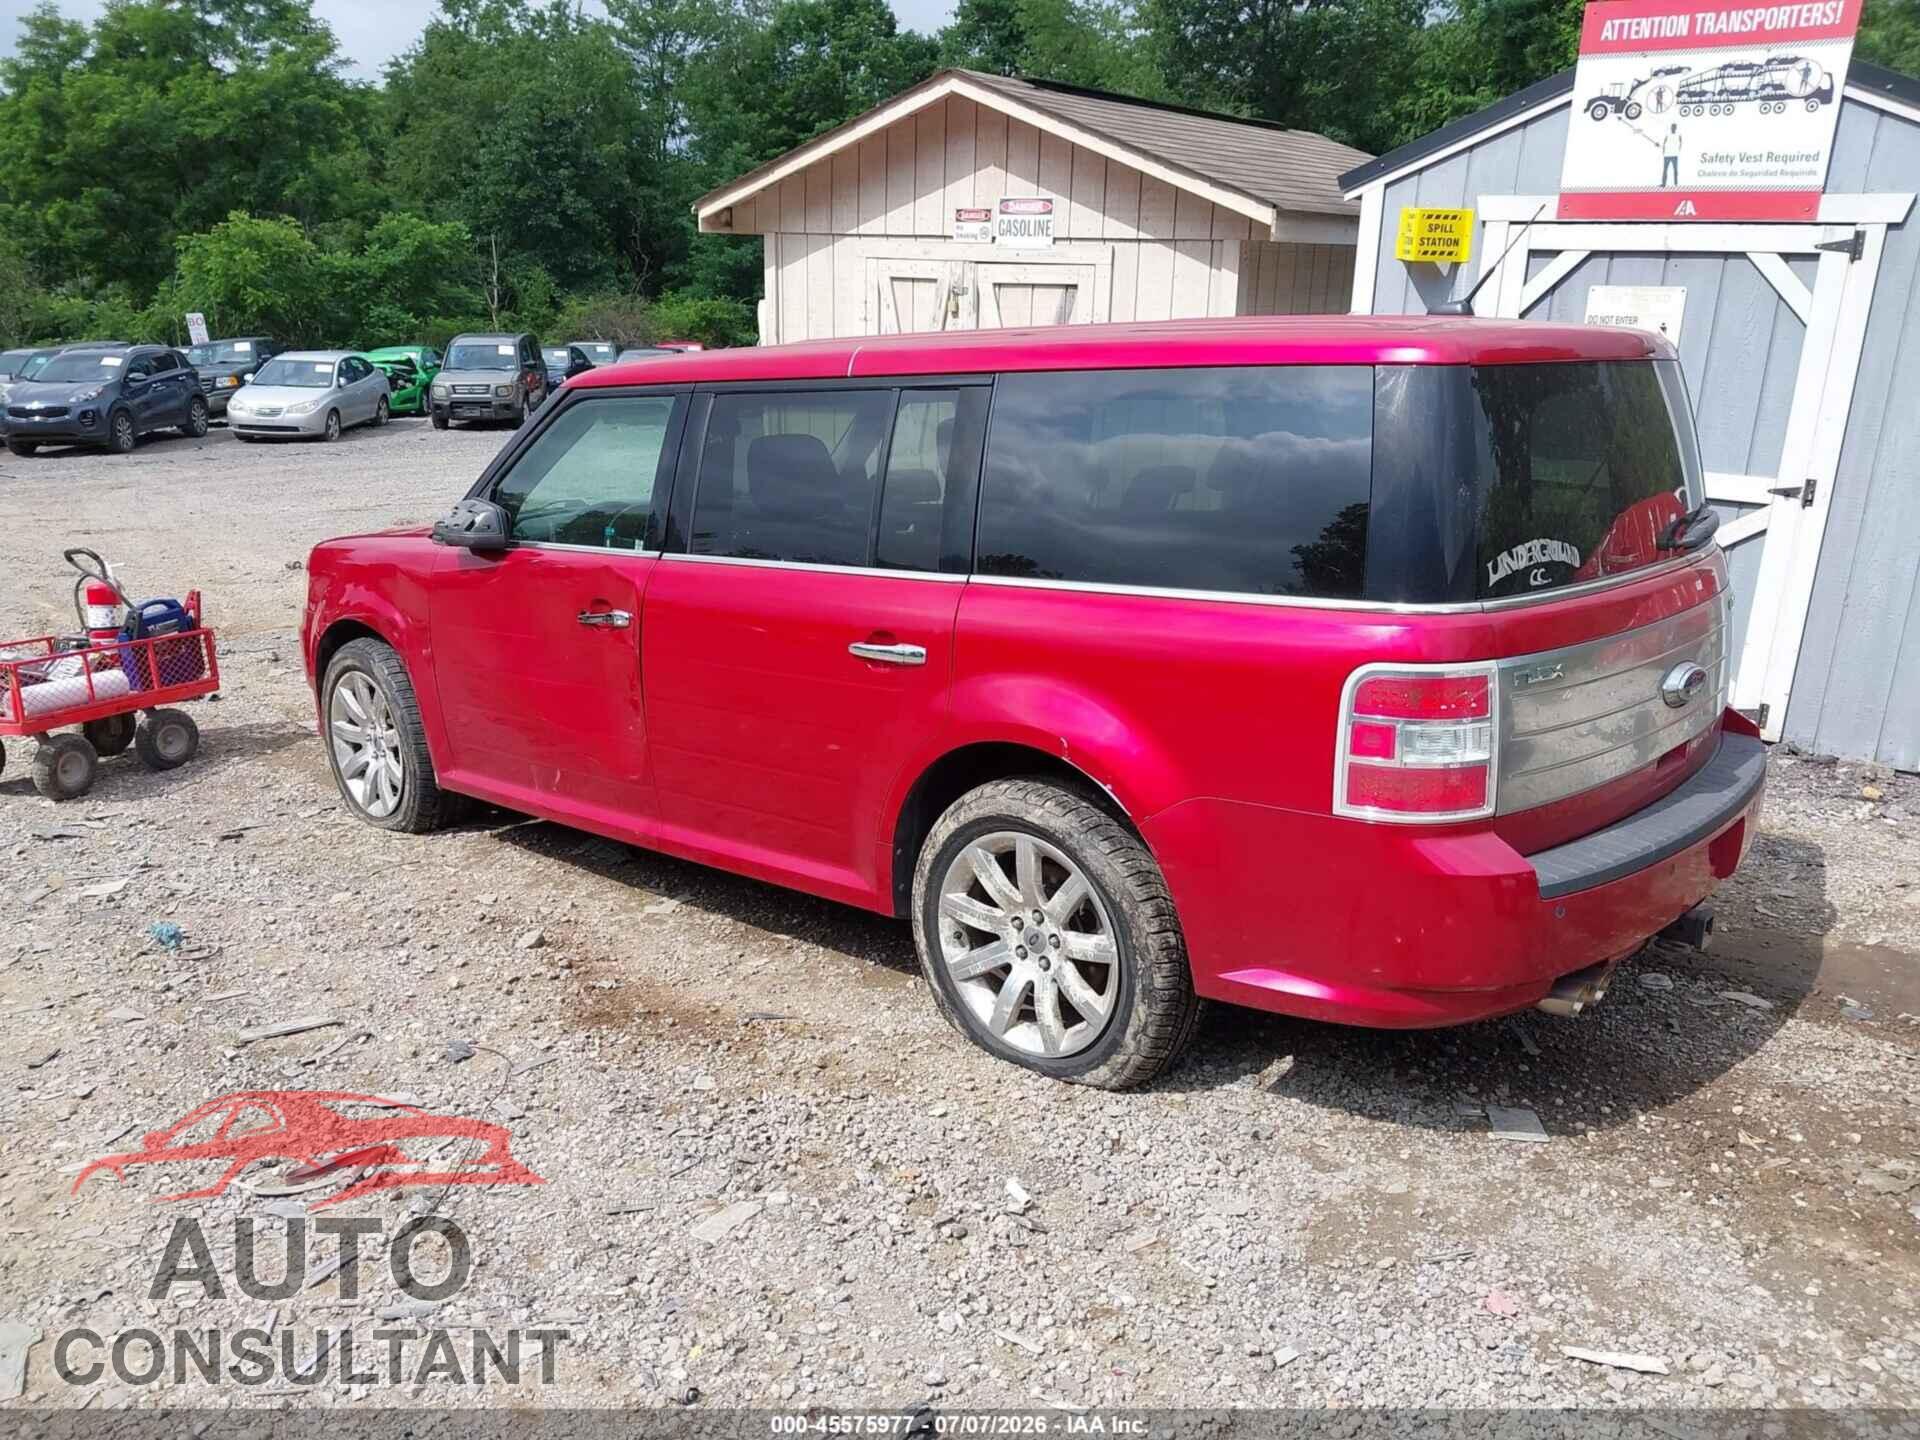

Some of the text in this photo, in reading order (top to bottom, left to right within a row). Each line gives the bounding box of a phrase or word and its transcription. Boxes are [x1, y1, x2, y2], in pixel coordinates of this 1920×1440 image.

[1600, 1, 1844, 41] ATTENTION TRANSPORTERS!
[1700, 150, 1820, 165] Safety Vest Required
[998, 219, 1052, 237] GASOLINE
[1427, 223, 1455, 233] SPILL
[1419, 237, 1460, 247] STATION
[1587, 315, 1638, 325] DO NOT ENTER
